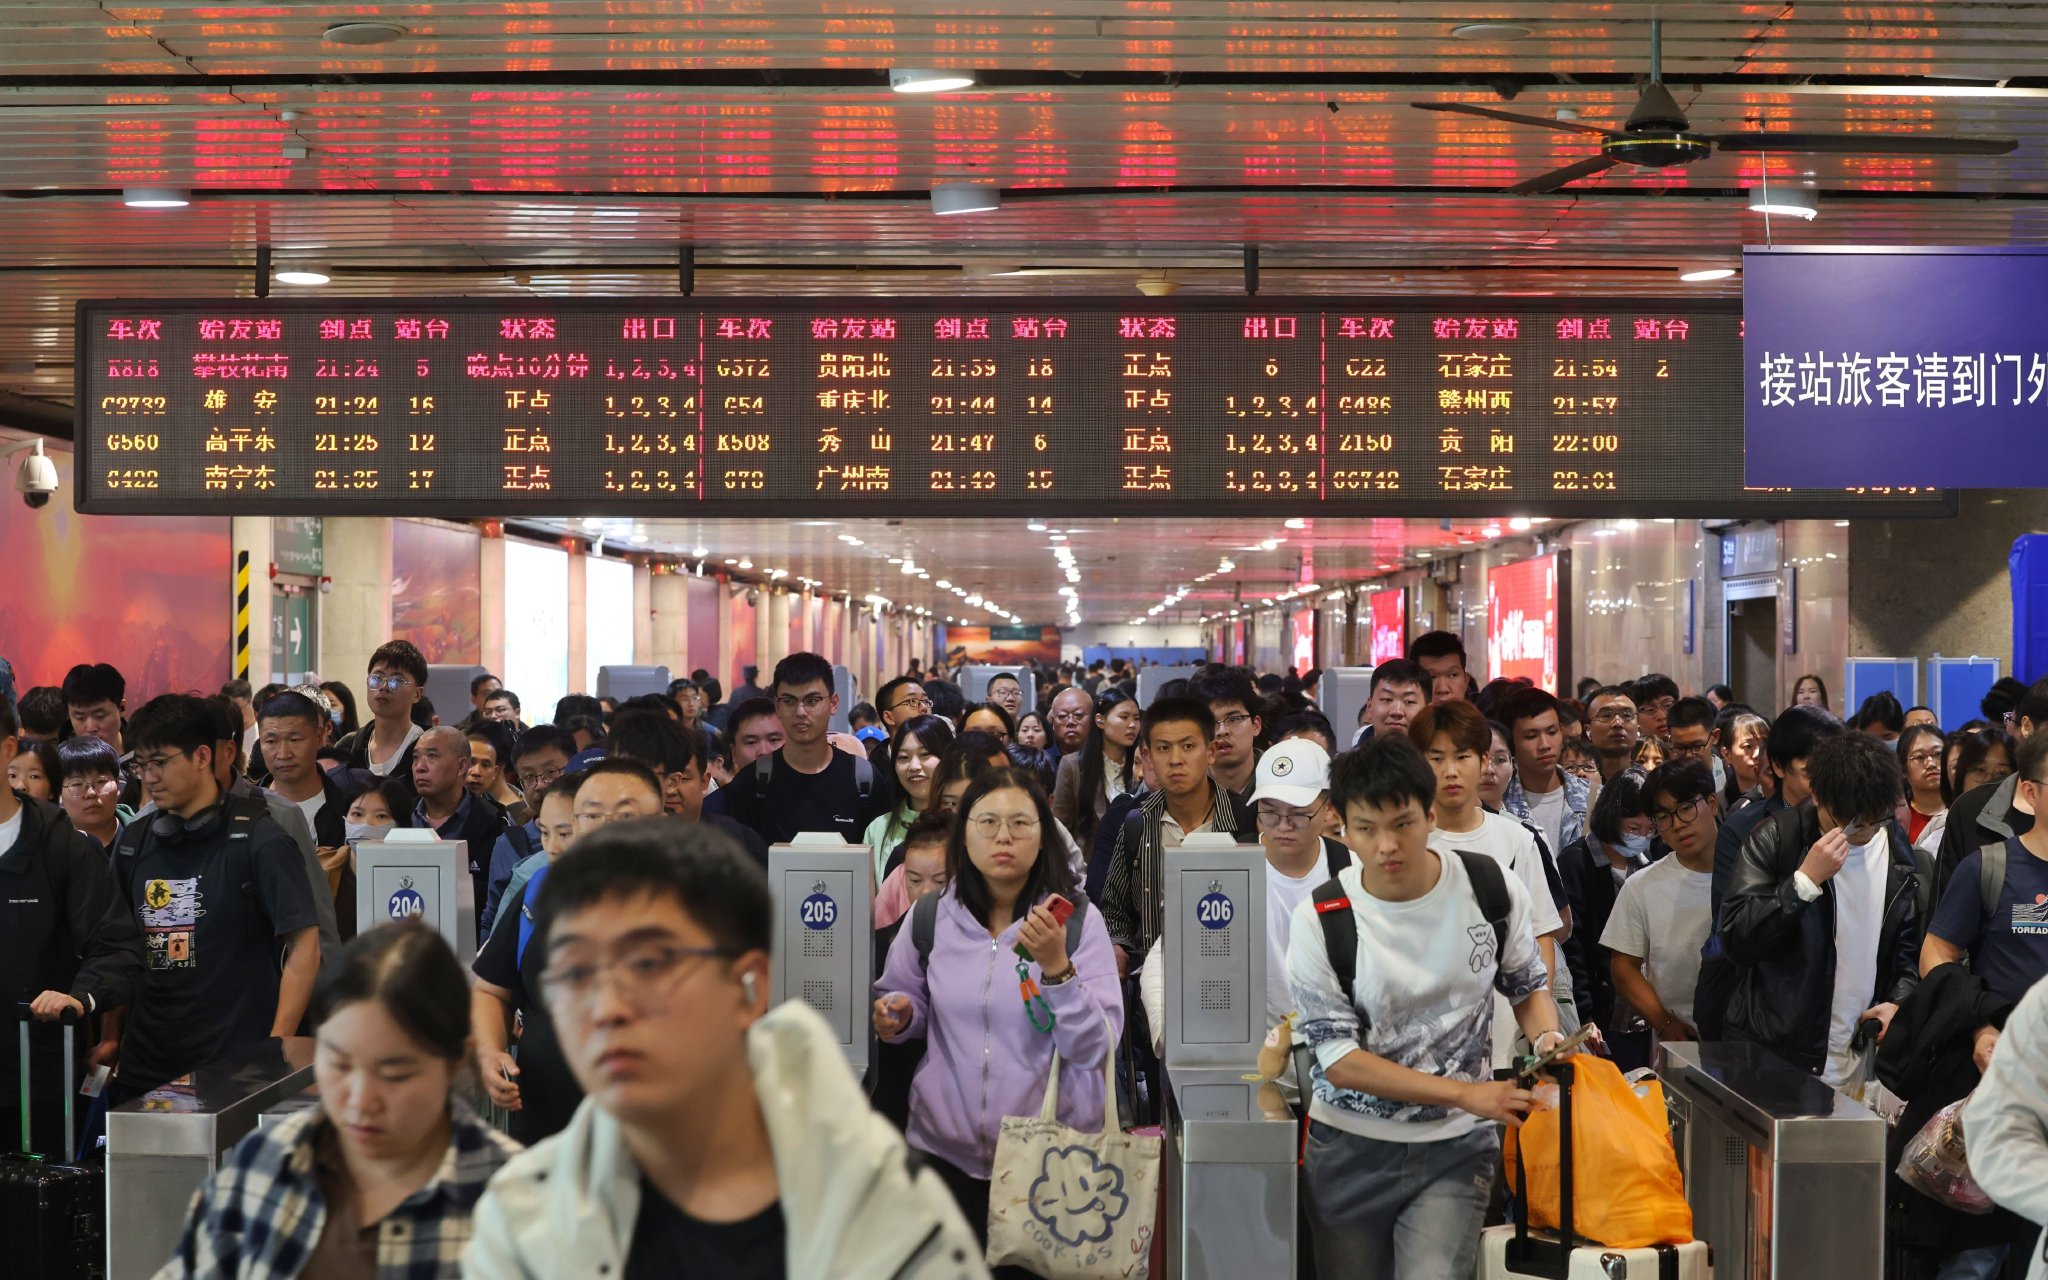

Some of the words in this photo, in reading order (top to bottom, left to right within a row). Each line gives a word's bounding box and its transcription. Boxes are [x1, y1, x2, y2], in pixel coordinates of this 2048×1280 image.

[107, 320, 161, 340] 车次
[199, 319, 281, 340] 始发站
[320, 319, 373, 339] 到点
[395, 319, 449, 339] 站台
[500, 318, 555, 339] 状态
[623, 318, 675, 339] 出口
[716, 318, 772, 339] 车次
[811, 318, 896, 339] 始发站
[934, 318, 989, 339] 到点
[1012, 318, 1067, 338] 站台
[1119, 317, 1175, 338] 状态
[1244, 318, 1296, 338] 出口
[1338, 318, 1394, 338] 车次
[1433, 318, 1518, 339] 始发站
[1556, 318, 1612, 339] 到点
[1633, 319, 1688, 339] 站台
[316, 360, 378, 376] 21:24
[418, 360, 428, 376] 5
[606, 359, 695, 379] 1,2,3,4
[818, 353, 890, 377] 贵阳北
[1028, 359, 1052, 376] 18
[1123, 353, 1171, 377] 正点
[1266, 359, 1277, 375] 6
[1439, 353, 1512, 378] 石家庄
[1554, 360, 1617, 377] 21:54
[1657, 360, 1668, 377] 2
[316, 397, 377, 414] 21:24
[410, 397, 433, 414] 16
[505, 390, 550, 413] 正点
[606, 397, 695, 417] 1,2,3,4
[817, 389, 890, 414] 重庆北
[932, 397, 995, 414] 21:44
[1028, 397, 1052, 413] 14
[1125, 389, 1171, 413] 正点
[1227, 397, 1317, 417] 1,2,3,4
[1554, 397, 1618, 414] 21:57
[108, 435, 158, 450] G560
[316, 435, 378, 450] 21:25
[410, 435, 434, 450] 12
[503, 428, 550, 452] 正点
[606, 435, 695, 453] 1,2,3,4
[932, 435, 994, 451] 21:47
[1035, 435, 1046, 450] 6
[1123, 428, 1171, 452] 正点
[1227, 435, 1317, 453] 1,2,3,4
[1554, 435, 1617, 451] 22:00
[205, 465, 275, 489] 南宁东
[410, 471, 433, 488] 17
[503, 465, 550, 490] 正点
[606, 471, 694, 491] 1,2,3,4
[816, 466, 889, 490] 广州南
[1028, 471, 1052, 488] 15
[1123, 465, 1170, 490] 正点
[1227, 471, 1316, 491] 1,2,3,4
[1439, 466, 1512, 490] 石家庄
[1554, 472, 1616, 489] 22:01
[392, 896, 421, 917] 204
[804, 901, 834, 922] 205
[1201, 900, 1231, 921] 206
[2011, 926, 2048, 934] TOREAD
